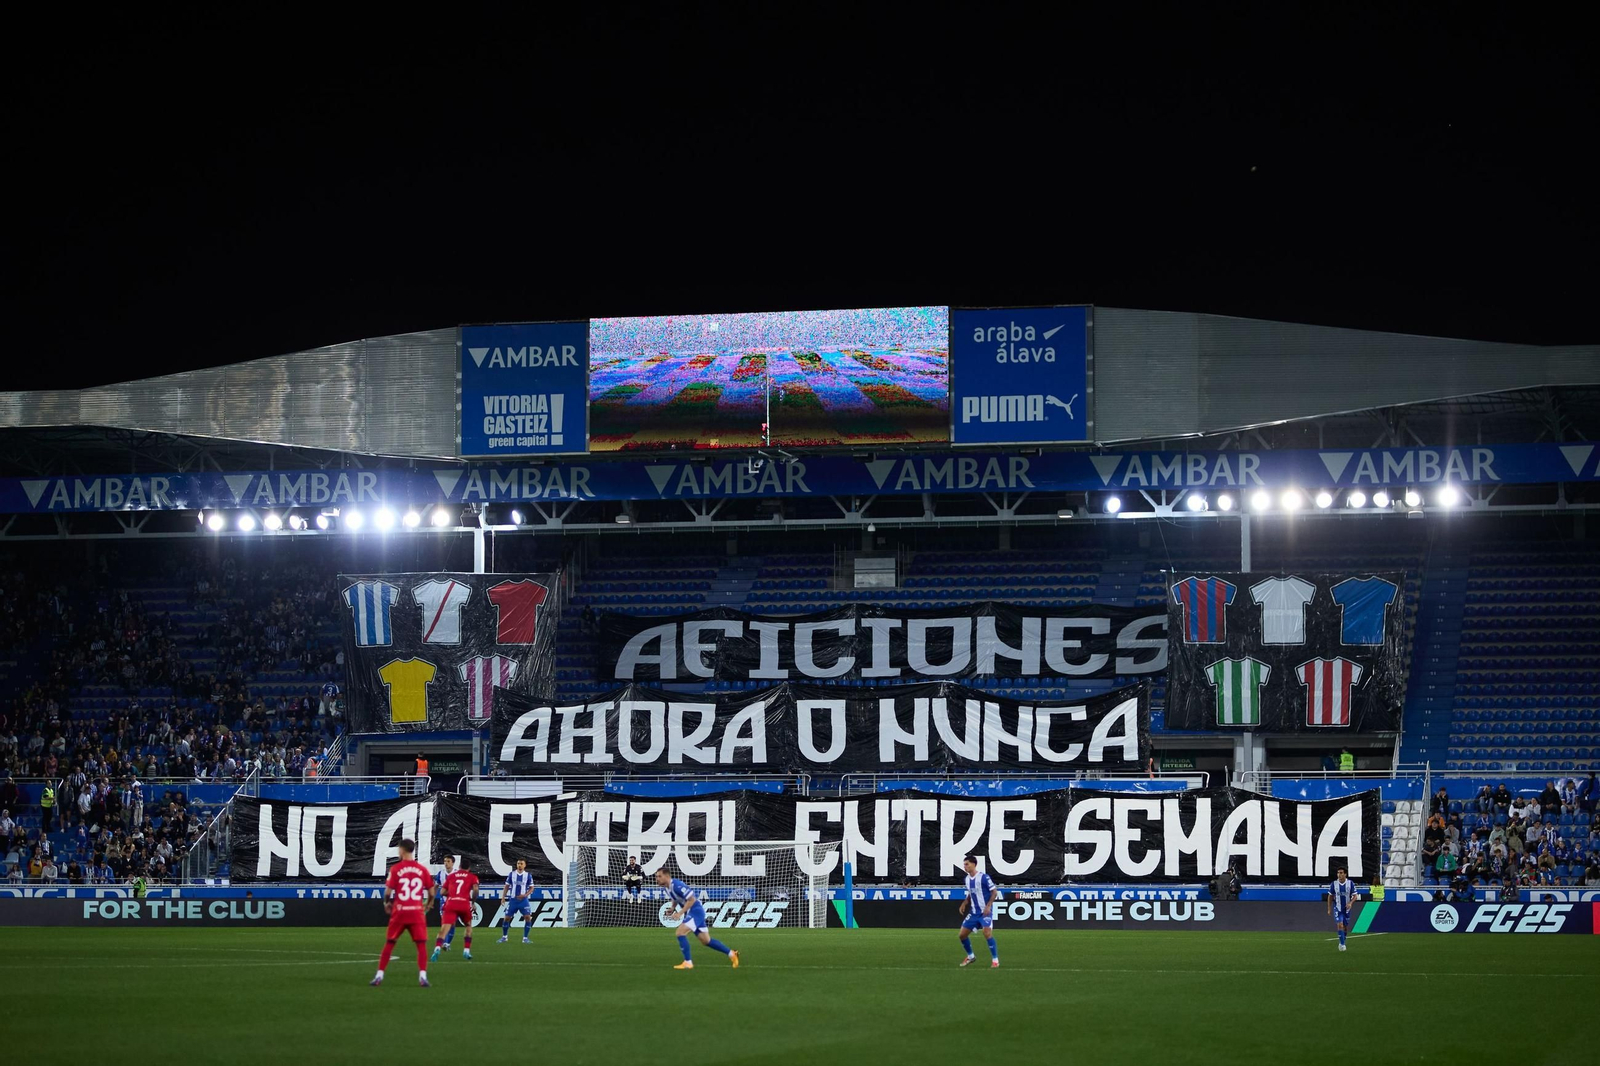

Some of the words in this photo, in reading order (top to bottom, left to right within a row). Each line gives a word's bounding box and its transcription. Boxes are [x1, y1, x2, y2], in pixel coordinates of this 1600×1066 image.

[973, 321, 1036, 342] araba
[488, 345, 580, 369] AMBAR
[996, 342, 1056, 363] álava
[483, 394, 549, 415] VITORIA
[962, 394, 1044, 423] PUMA
[483, 414, 549, 435] GASTEIZ
[488, 436, 515, 449] green
[516, 434, 548, 447] capital
[674, 462, 812, 496] AMBAR
[892, 456, 1036, 491] AMBAR
[1123, 453, 1267, 487] AMBAR
[1352, 447, 1502, 484] AMBAR
[48, 477, 171, 509] AMBAR
[252, 472, 382, 504] AMBAR
[462, 467, 597, 500] AMBAR
[499, 699, 768, 765] AHORA
[796, 699, 847, 764] O
[879, 697, 1139, 763] NUNCA
[256, 803, 348, 878] NO
[371, 801, 462, 878] AL
[794, 799, 1038, 877] ENTRE
[1063, 797, 1363, 878] SEMANA
[397, 877, 424, 902] 32
[455, 879, 465, 895] 7
[83, 900, 141, 919] FOR
[146, 900, 203, 919] THE
[208, 900, 286, 919] CLUB
[992, 901, 1055, 921] FOR
[1060, 901, 1123, 921] THE
[1129, 901, 1215, 921] CLUB
[1435, 910, 1454, 920] EA
[1465, 903, 1574, 932] FC25
